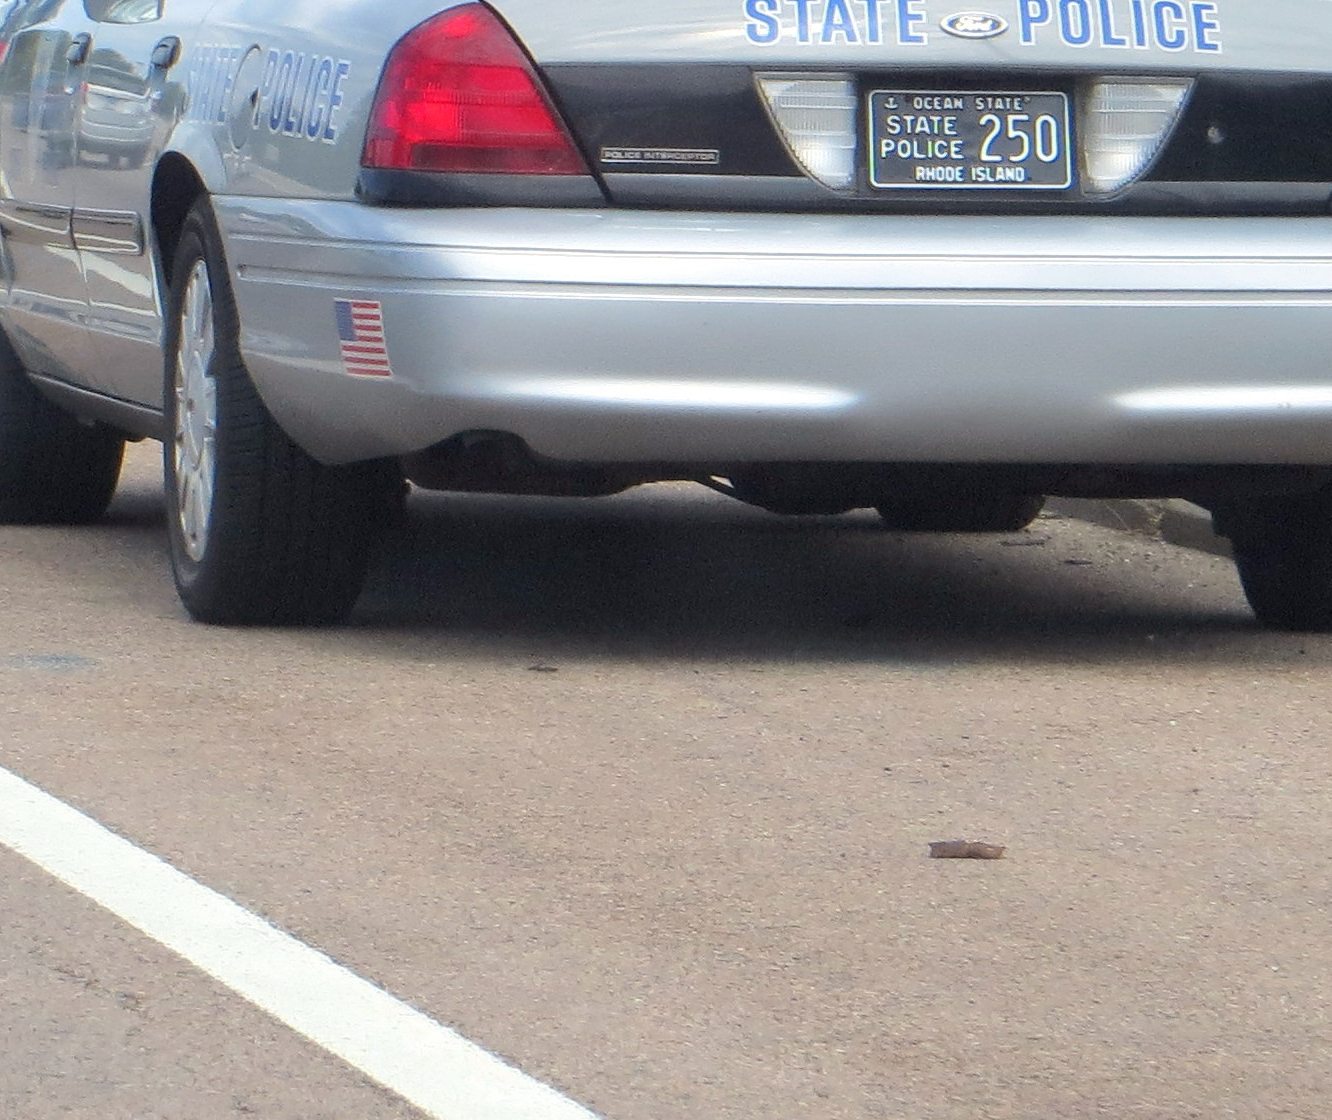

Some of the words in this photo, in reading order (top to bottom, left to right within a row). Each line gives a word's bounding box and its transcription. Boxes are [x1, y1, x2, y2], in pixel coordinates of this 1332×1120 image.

[253, 48, 351, 146] POLICE
[912, 96, 964, 110] OCEAN
[974, 97, 1023, 111] STATE
[886, 115, 958, 136] STATE
[978, 113, 1059, 163] 250
[604, 151, 641, 159] POLICE
[880, 139, 965, 159] POLICE
[915, 166, 965, 182] RHODE
[971, 166, 1026, 182] ISLAND
